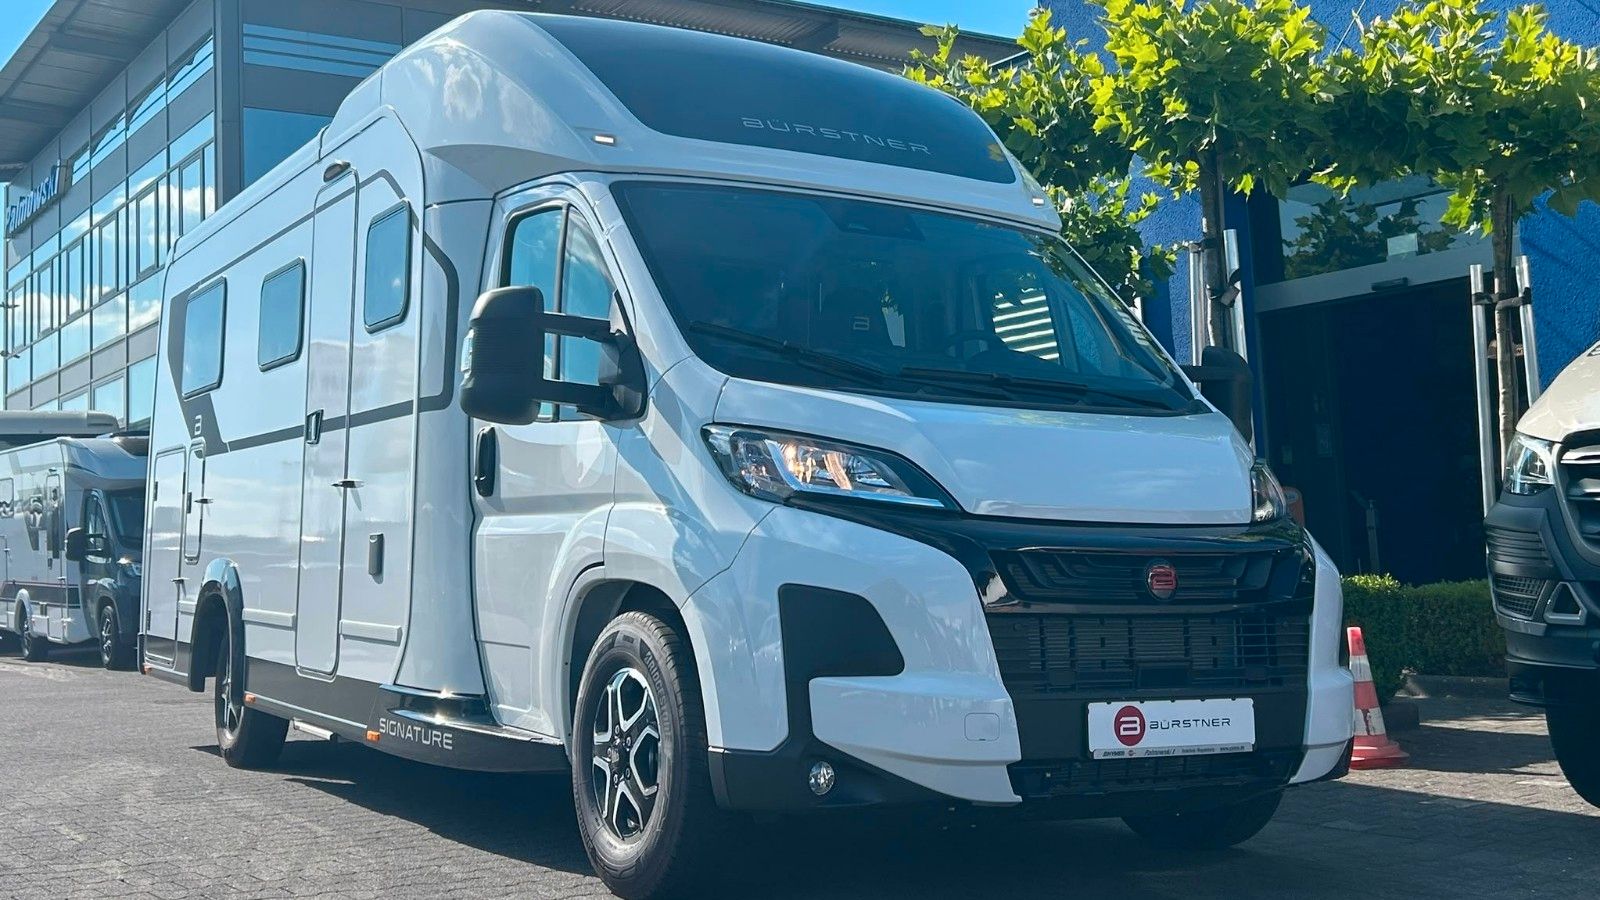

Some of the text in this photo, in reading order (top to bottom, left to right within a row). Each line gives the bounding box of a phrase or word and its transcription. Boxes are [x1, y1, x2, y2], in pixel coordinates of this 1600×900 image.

[741, 117, 931, 155] BÜRSTNER
[378, 717, 453, 750] SIGNATURE
[1149, 717, 1232, 730] BÜRSTNER
